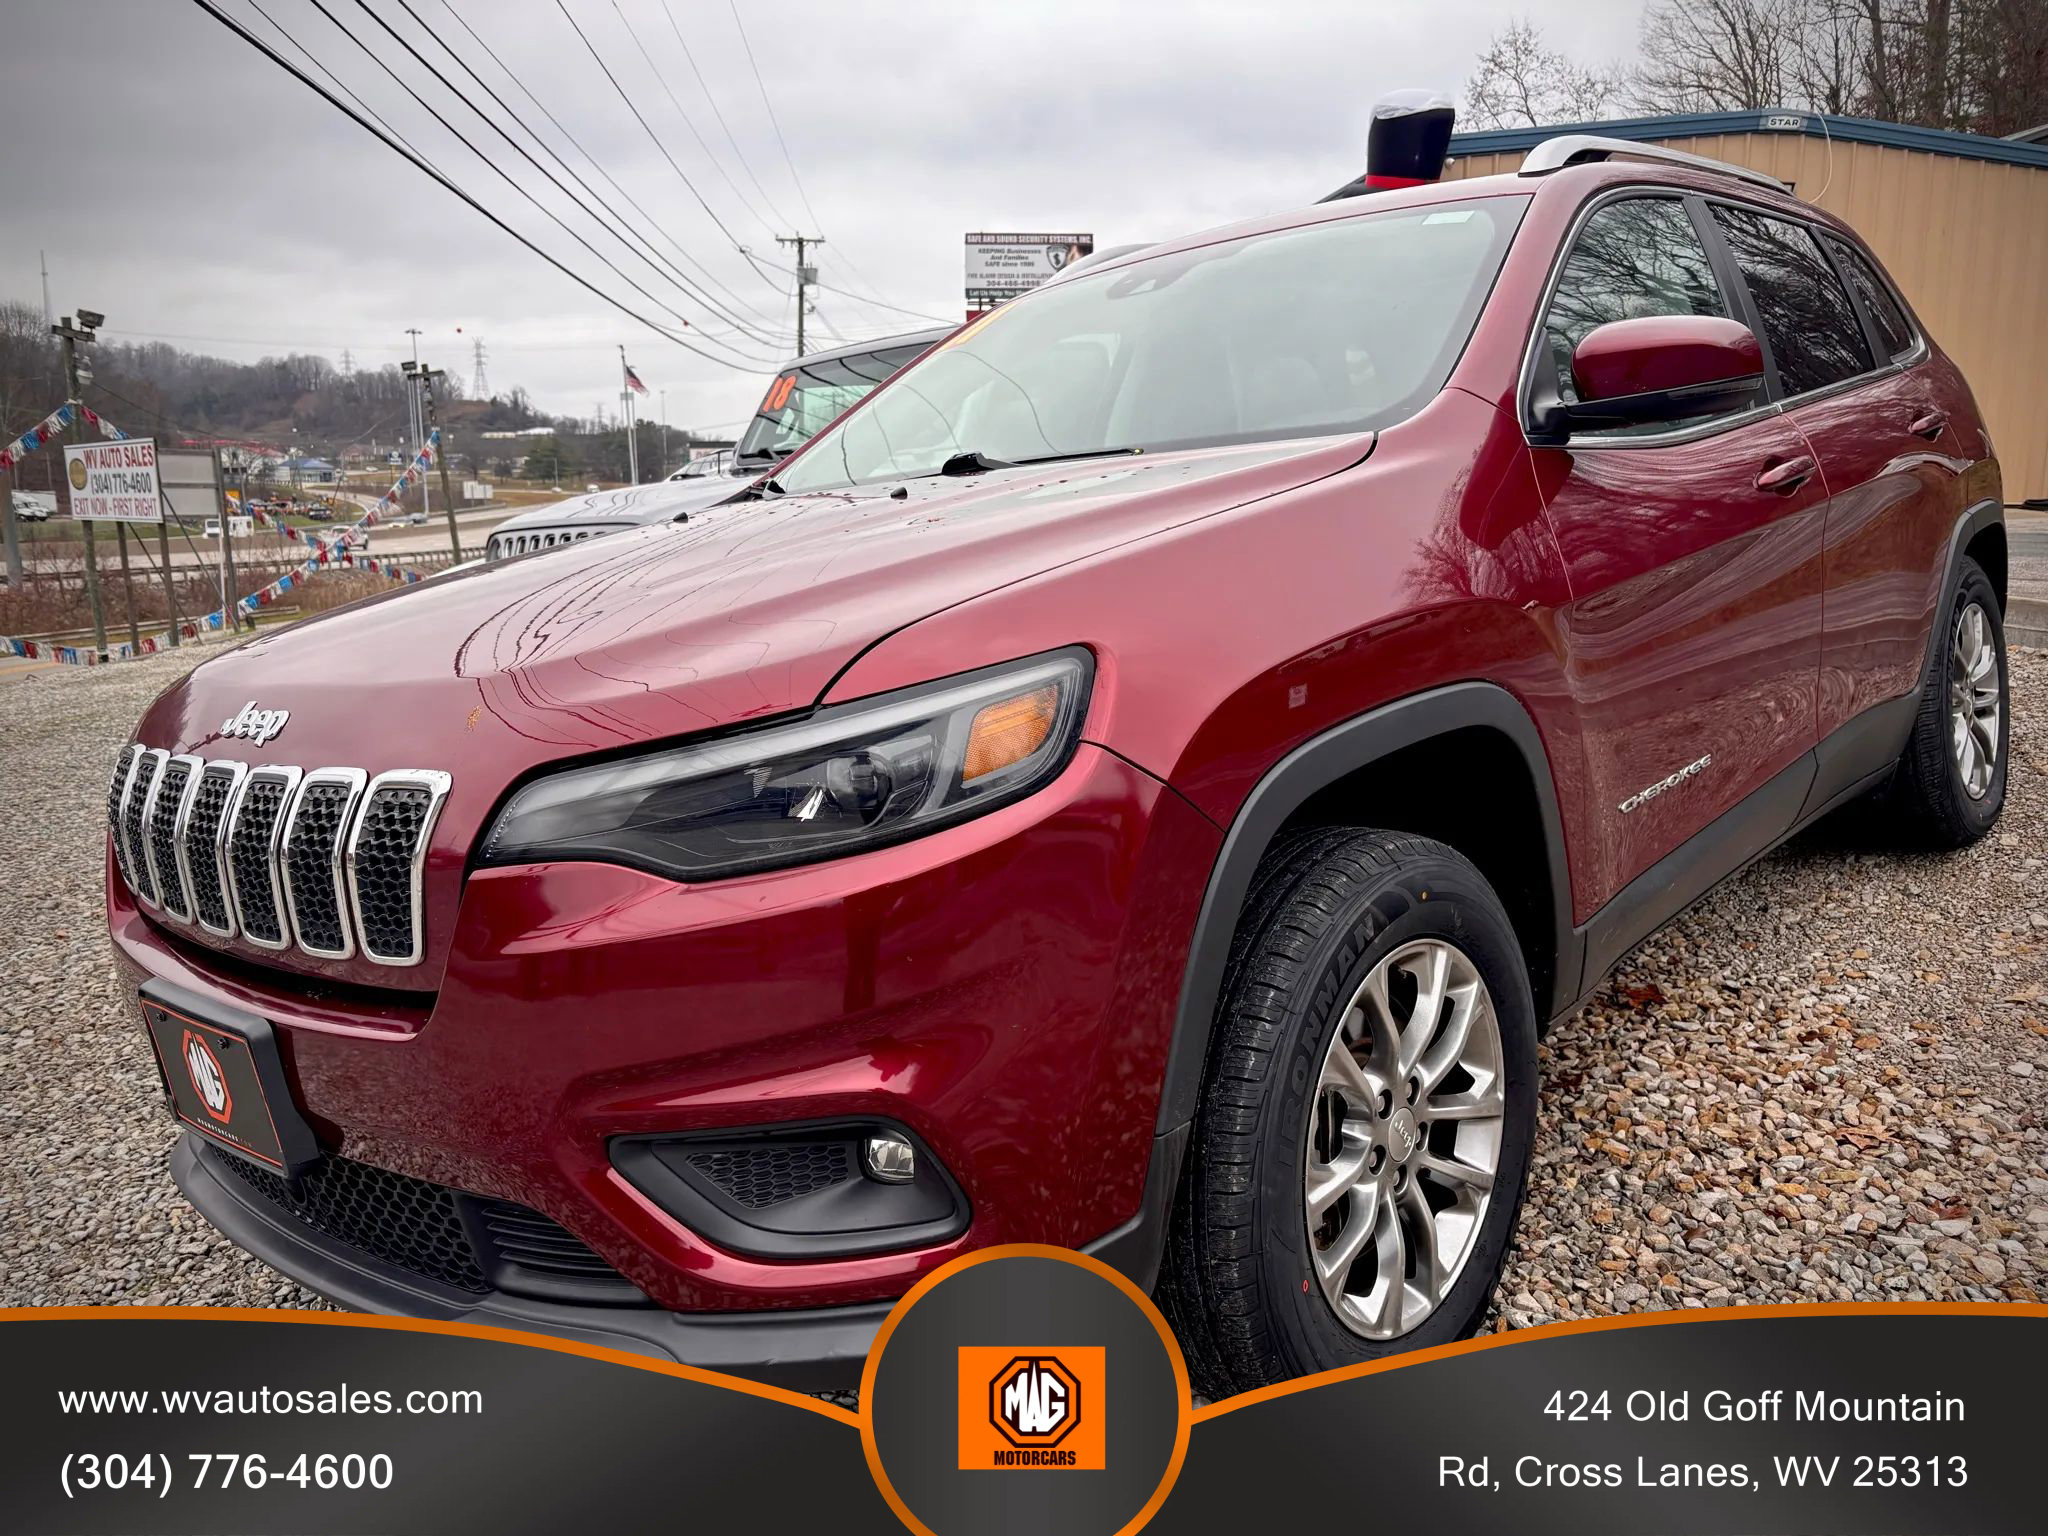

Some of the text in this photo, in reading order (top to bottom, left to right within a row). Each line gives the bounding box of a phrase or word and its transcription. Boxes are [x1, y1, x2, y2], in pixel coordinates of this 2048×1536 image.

[1770, 118, 1799, 126] STAR
[967, 235, 981, 243] SAFE
[982, 235, 995, 243] AND
[1019, 235, 1048, 243] SECURITY
[763, 375, 796, 412] 18
[83, 445, 154, 469] WV AUTO SALES
[74, 498, 89, 515] EXIT
[91, 498, 108, 515] NOW
[113, 498, 133, 516] FIRST
[135, 498, 158, 517] RIGHT
[220, 700, 291, 748] Jeep
[1618, 754, 1711, 813] CHEROKEE
[1278, 912, 1376, 1168] IRONMAN
[1394, 1119, 1412, 1148] Jeep
